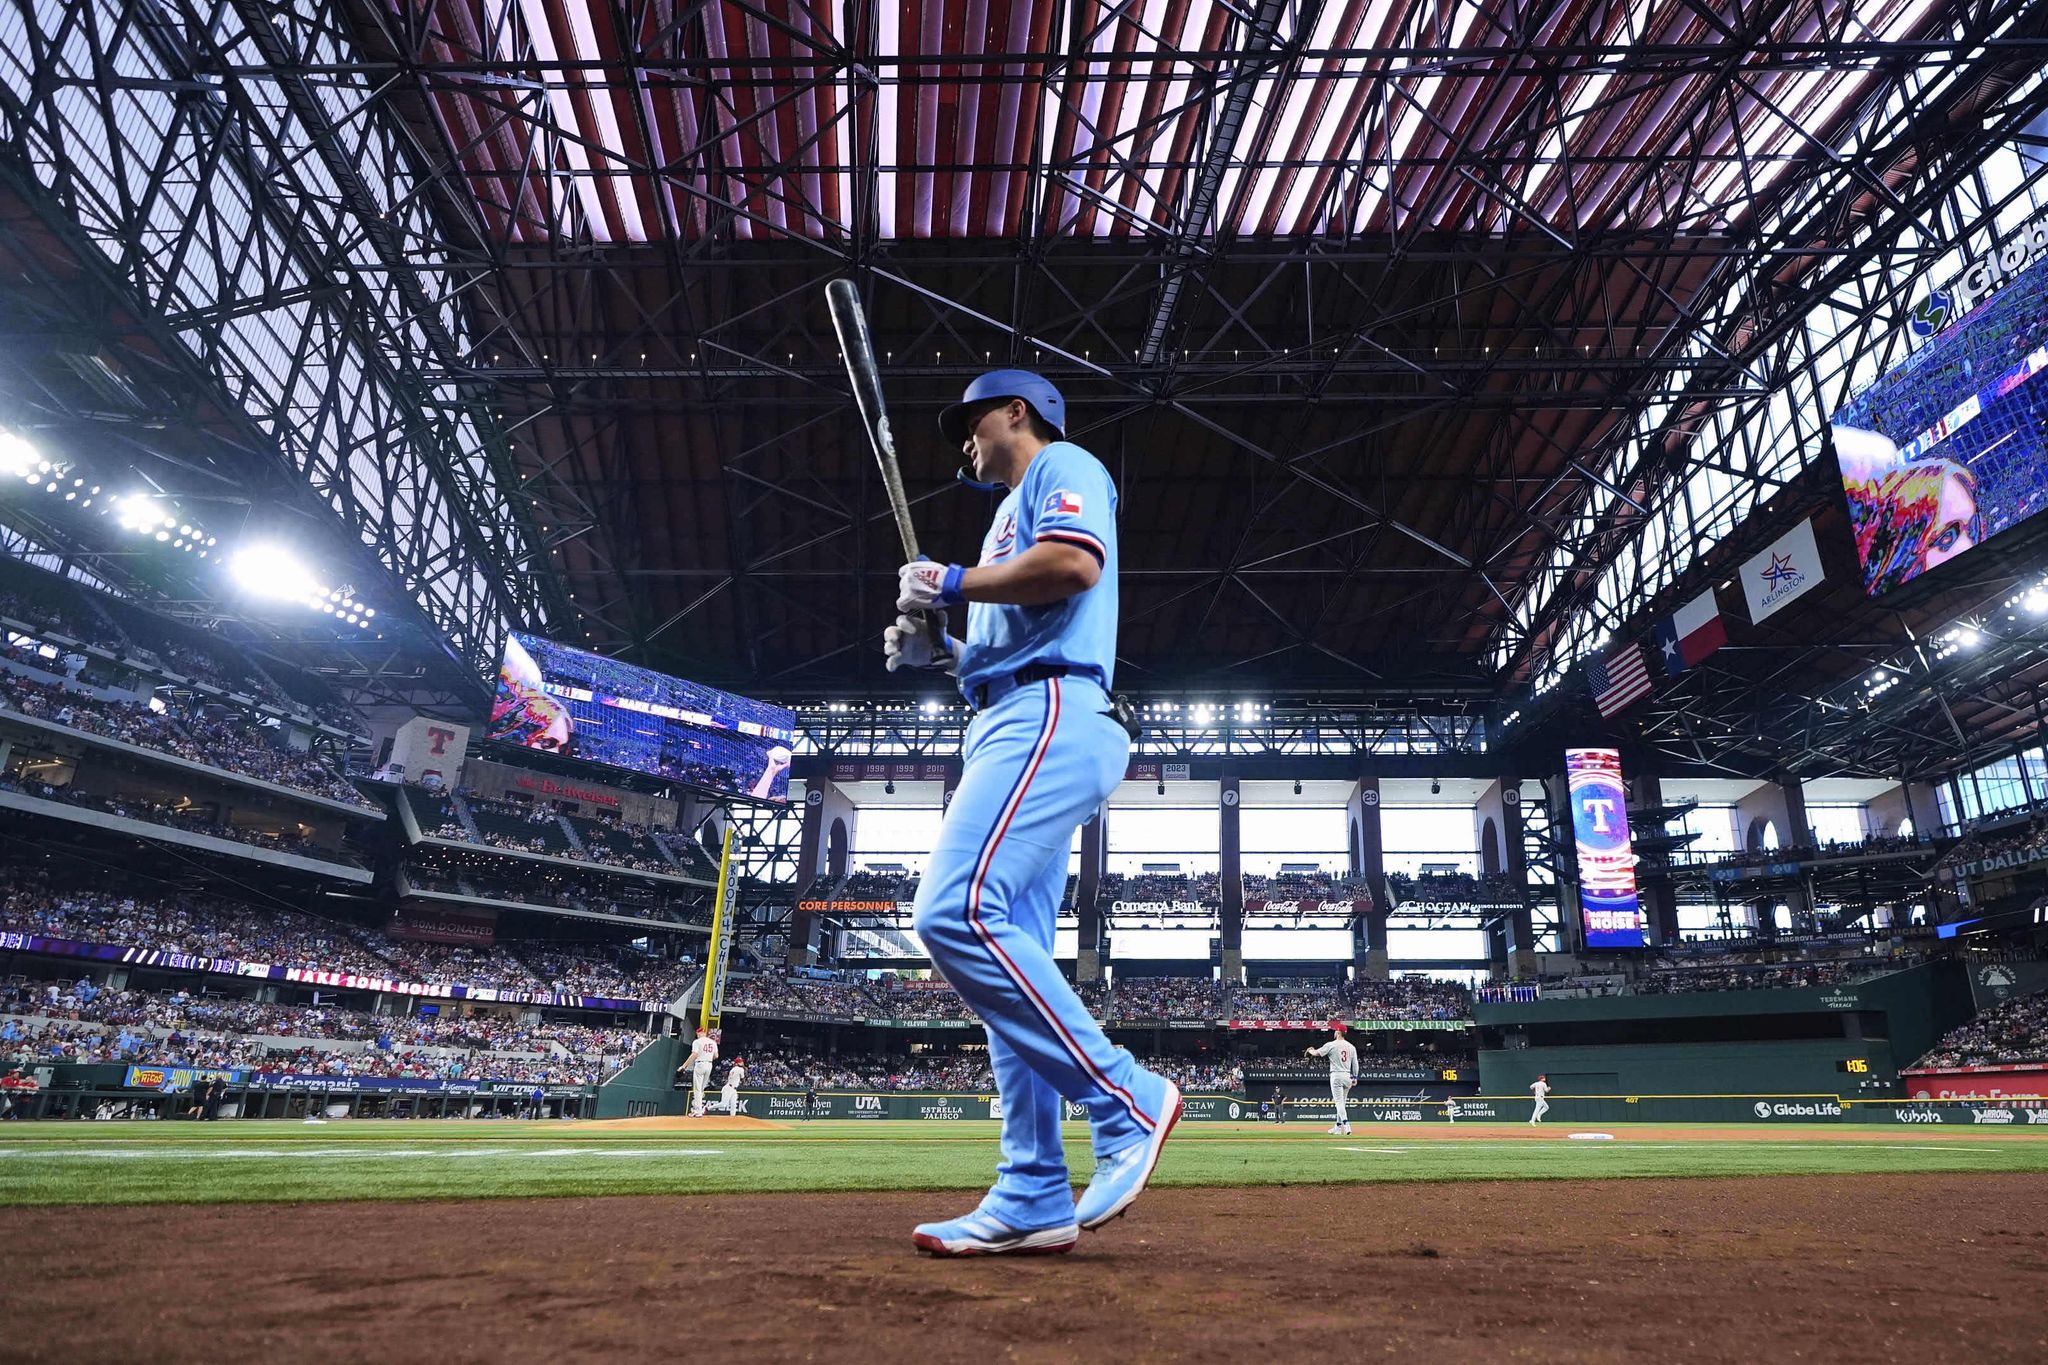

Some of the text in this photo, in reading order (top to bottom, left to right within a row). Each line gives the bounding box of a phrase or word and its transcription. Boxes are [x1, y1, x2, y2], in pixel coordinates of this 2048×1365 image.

[913, 572, 938, 591] adidas
[1761, 574, 1805, 607] ARLINGTON
[428, 726, 455, 754] T
[836, 764, 854, 773] 1996
[867, 764, 885, 773] 1998
[896, 764, 914, 773] 1999
[926, 764, 945, 773] 2010
[1137, 764, 1156, 773] 2016
[1166, 764, 1186, 772] 2023
[543, 780, 617, 806] Budweiser
[808, 793, 821, 802] 42
[1226, 793, 1234, 802] 7
[1364, 792, 1377, 802] 29
[1506, 793, 1516, 802] 10
[1583, 799, 1613, 832] T
[1954, 845, 2048, 878] UT DALLAS
[724, 864, 737, 914] ROOT
[799, 901, 827, 911] CORE
[830, 901, 895, 911] PERSONNEL
[1172, 900, 1203, 912] Bank
[1263, 900, 1300, 912] Coca-Cola
[1317, 900, 1354, 912] Coca-Cola
[1407, 901, 1470, 912] CHOCTAW
[439, 922, 493, 936] DONATED
[1591, 918, 1635, 929] NOISE
[1774, 932, 1862, 943] HARGROVE ROOFING
[1686, 940, 1727, 948] PRIORITY
[711, 937, 728, 1013] CHIKIN
[286, 968, 452, 997] MAKE SOME NOISE
[869, 1018, 891, 1026] 7-ELEVEN
[1366, 1020, 1462, 1030] LUXOR STAFFING
[703, 1043, 713, 1053] 45
[1341, 1050, 1347, 1063] 3
[1847, 1060, 1867, 1073] 1:06
[173, 1069, 193, 1087] HOW
[1443, 1070, 1458, 1080] 1:06
[279, 1075, 360, 1088] Germania
[450, 1083, 477, 1091] Germania
[855, 1096, 881, 1110] UTA
[1294, 1097, 1411, 1107] LOCKHED MARTIN
[1940, 1089, 2041, 1108] State Farm
[1774, 1103, 1841, 1115] Globe Life
[1982, 1109, 2007, 1118] ARROW
[1385, 1110, 1401, 1120] AIR
[1896, 1109, 1943, 1123] Kubota
